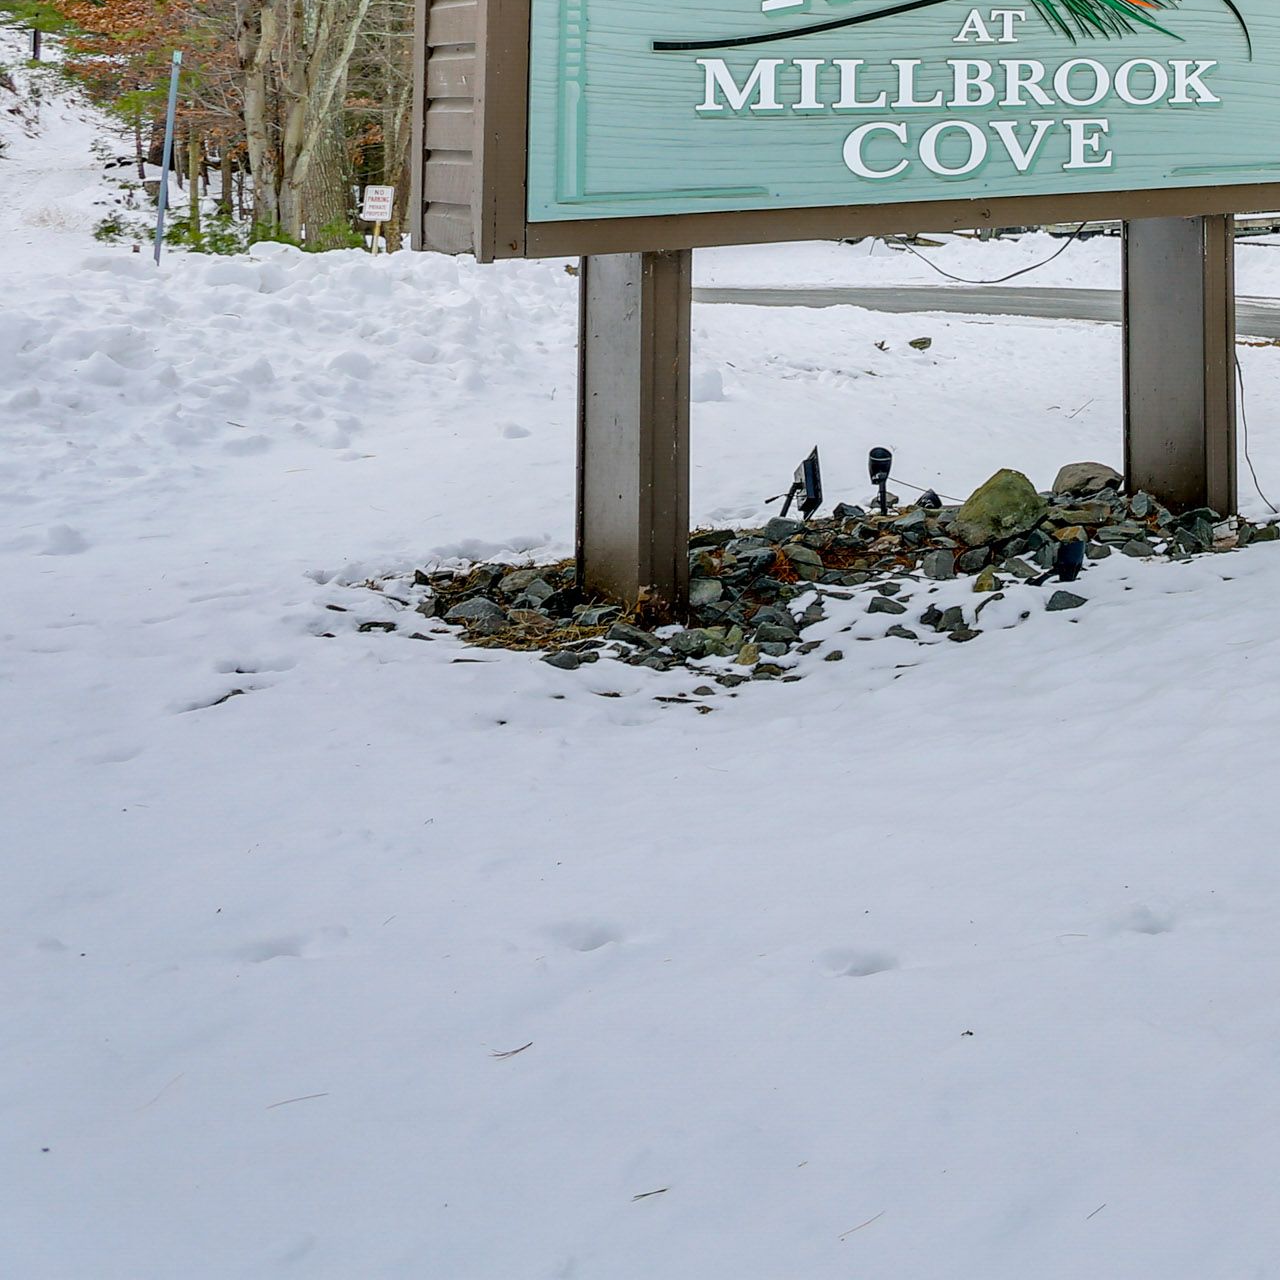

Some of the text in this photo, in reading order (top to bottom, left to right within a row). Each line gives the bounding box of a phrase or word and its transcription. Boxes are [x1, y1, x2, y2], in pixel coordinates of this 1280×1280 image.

[952, 9, 1026, 43] AT
[695, 57, 1222, 111] MILLBROOK
[842, 118, 1114, 179] COVE
